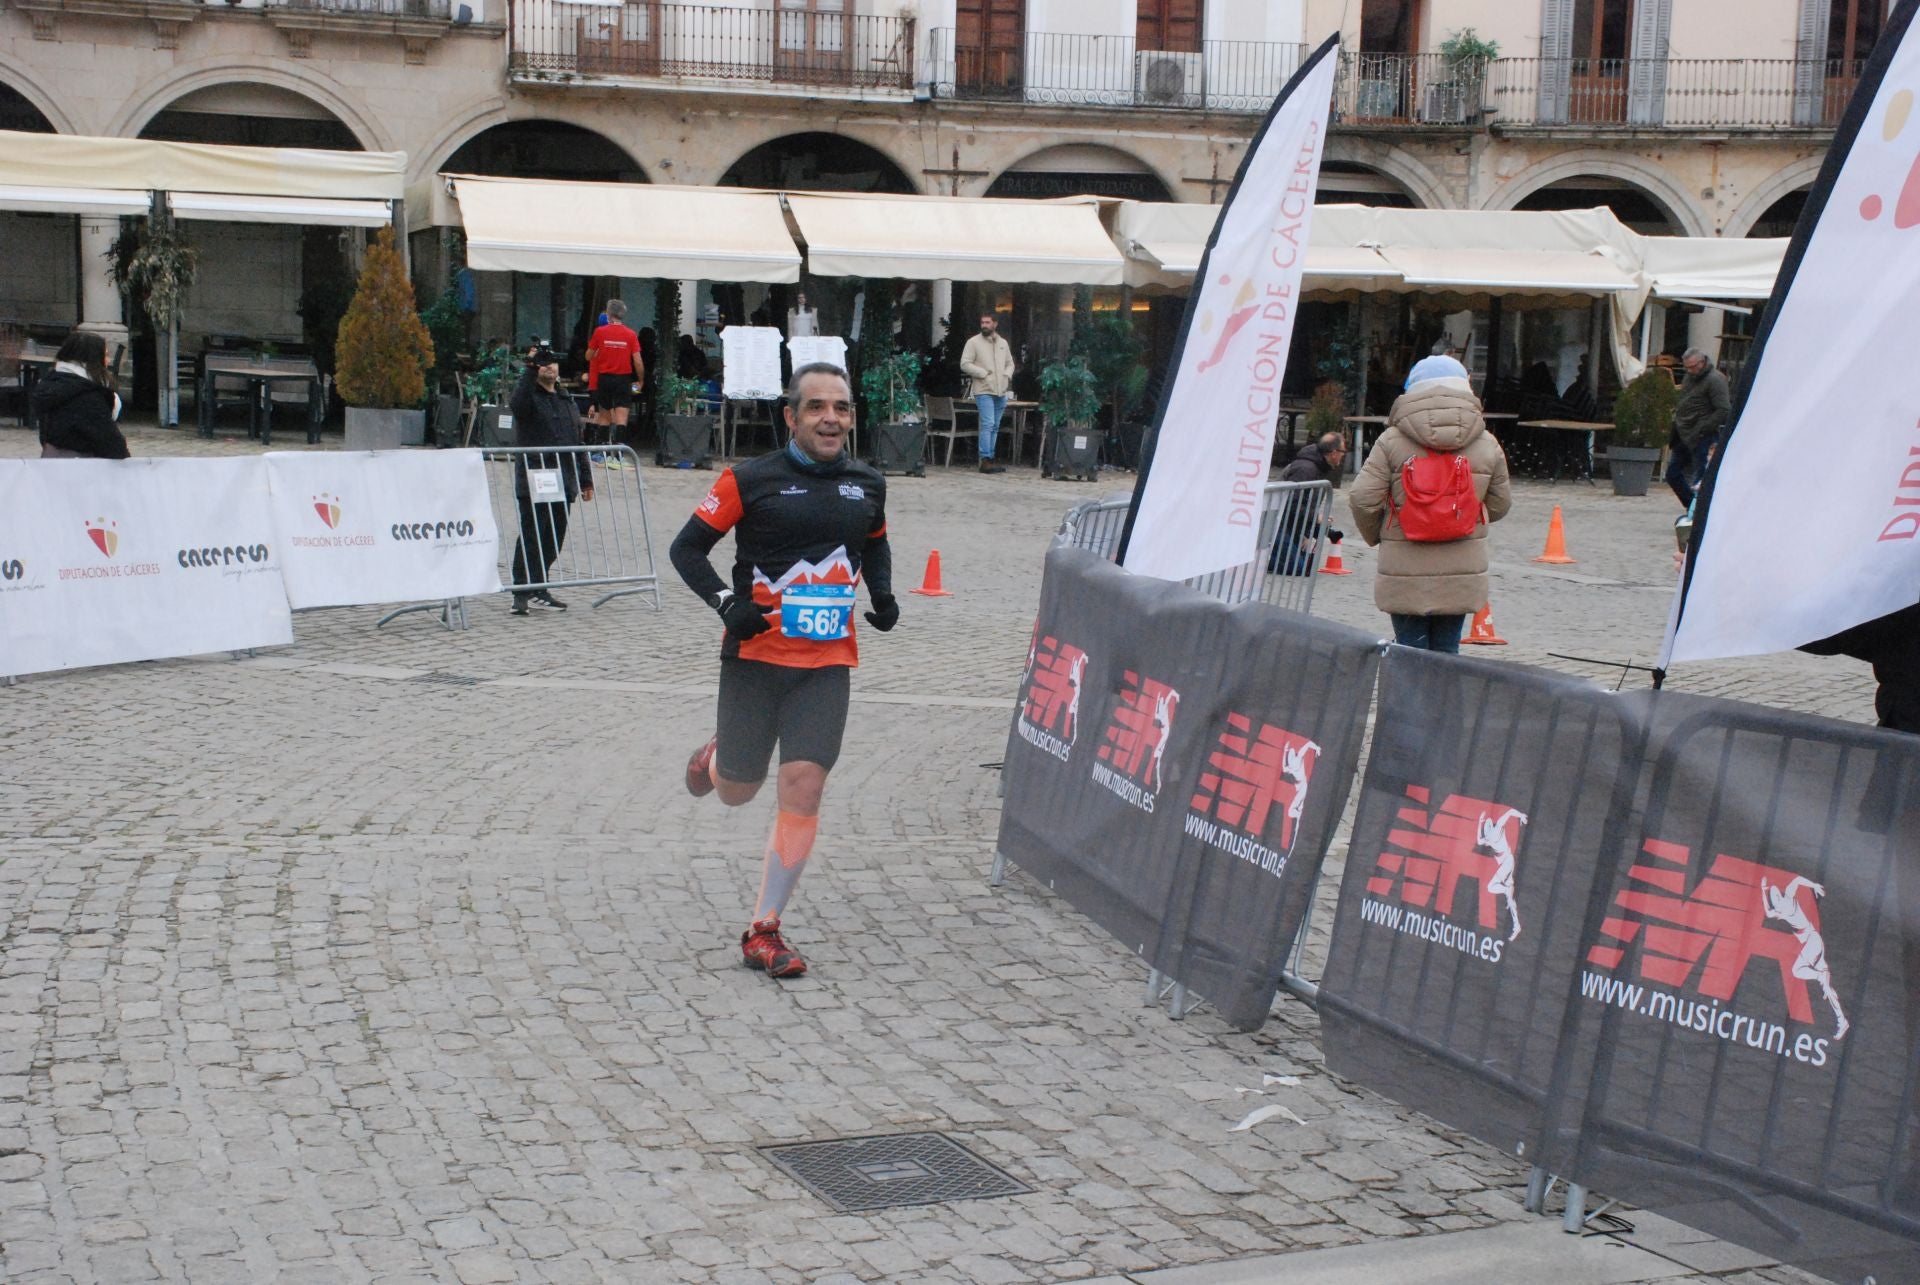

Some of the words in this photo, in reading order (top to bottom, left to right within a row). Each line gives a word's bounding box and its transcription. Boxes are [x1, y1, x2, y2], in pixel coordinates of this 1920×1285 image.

[1227, 329, 1282, 529] DIPUTACIÓN
[1263, 283, 1292, 323] DE
[110, 565, 122, 578] DE
[797, 608, 841, 636] 568
[1092, 761, 1155, 814] www.musicrun.es
[1184, 812, 1287, 879] www.musicrun.e
[1361, 898, 1505, 963] www.musicrun.es
[1581, 969, 1829, 1067] www.musicrun.es
